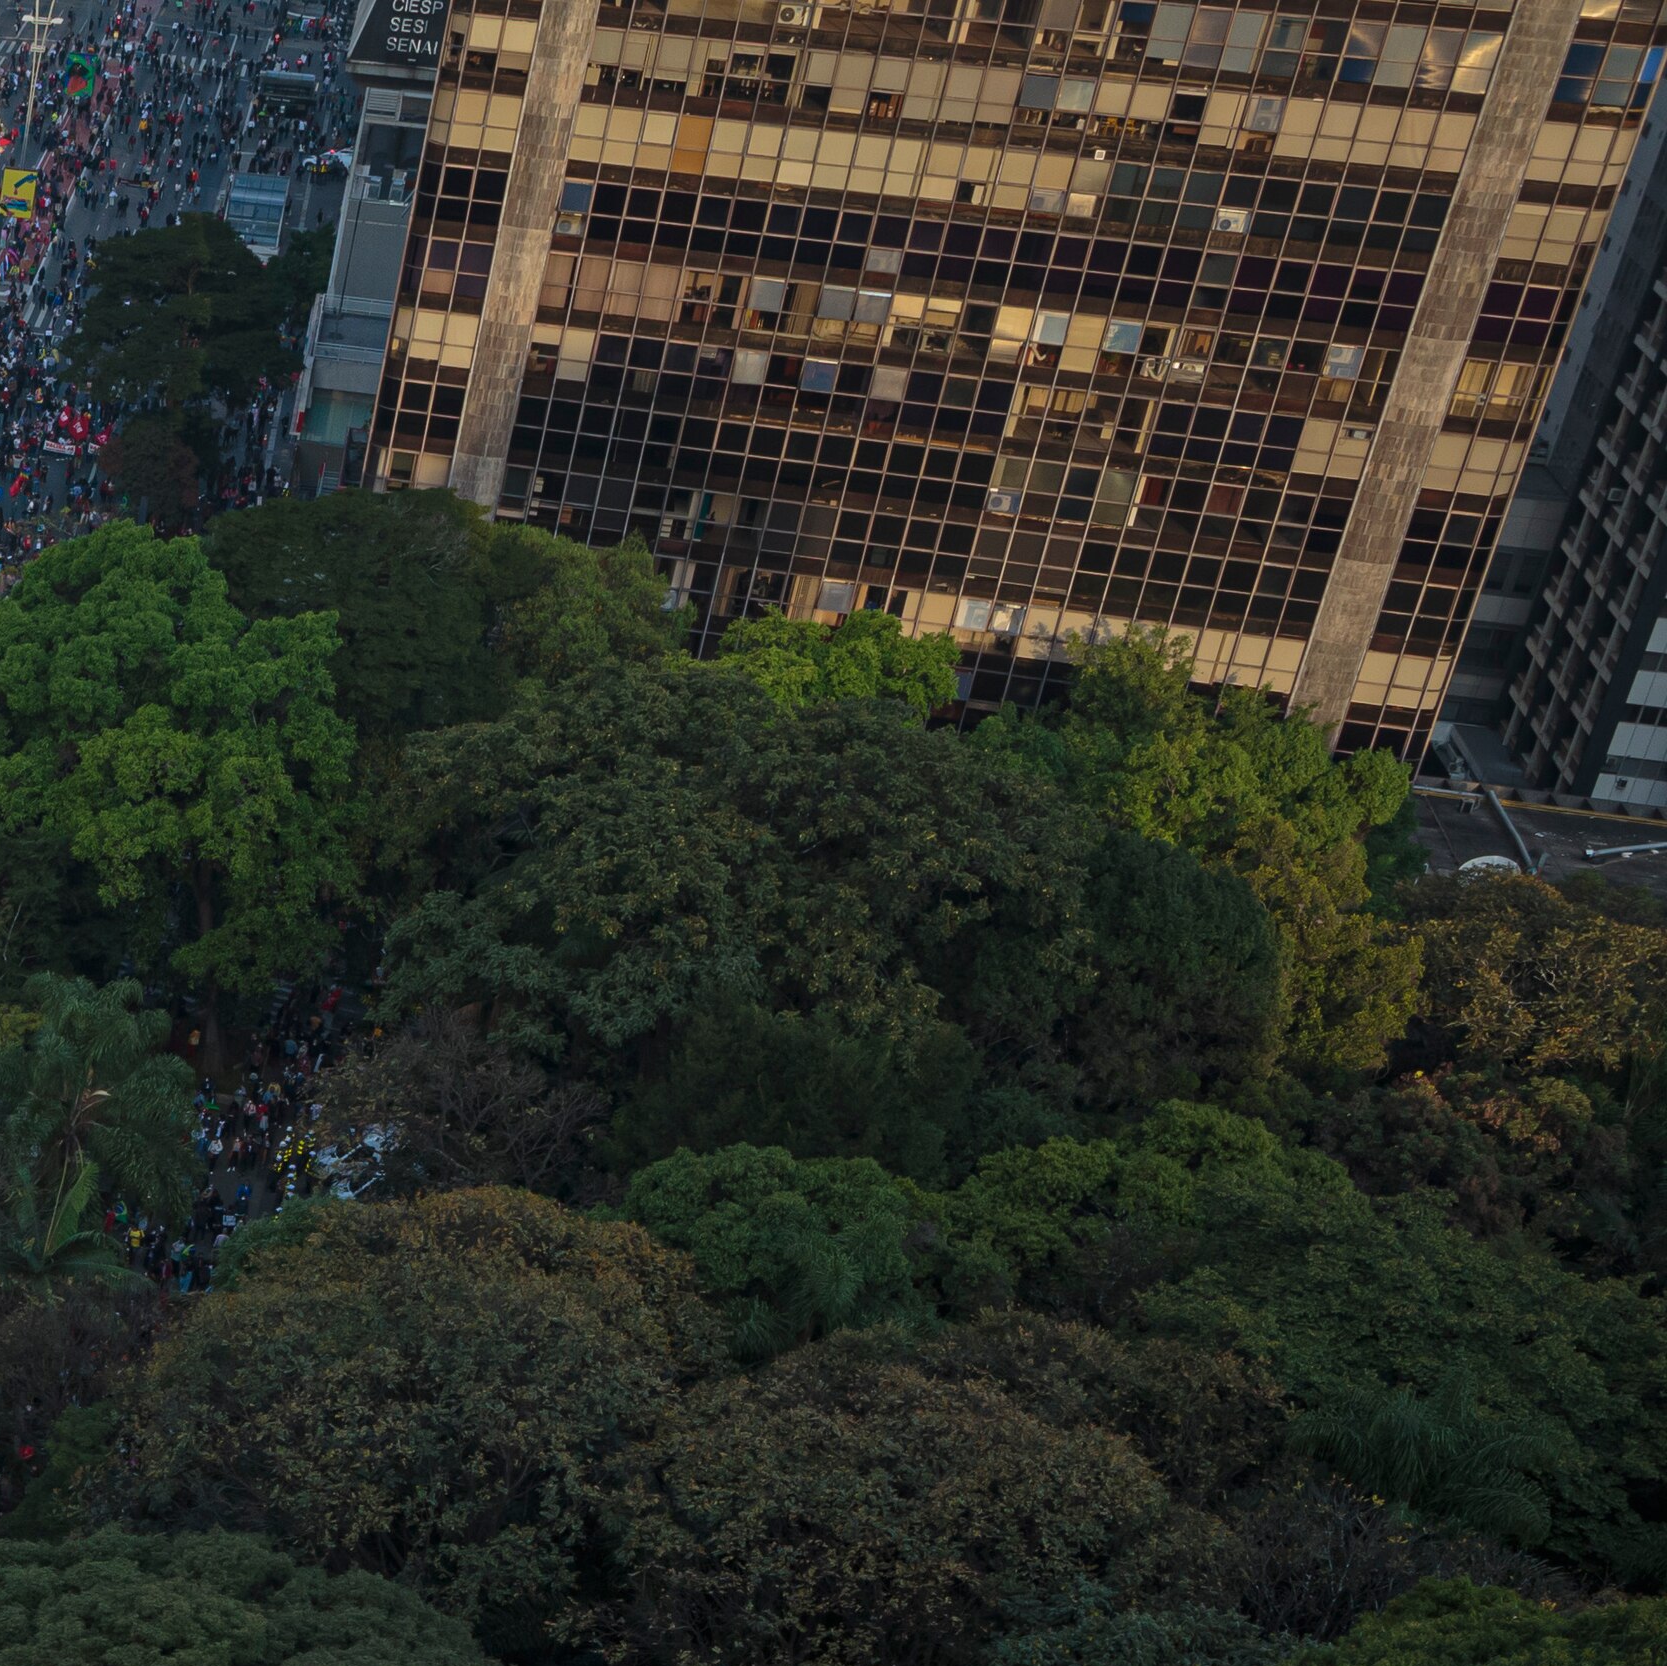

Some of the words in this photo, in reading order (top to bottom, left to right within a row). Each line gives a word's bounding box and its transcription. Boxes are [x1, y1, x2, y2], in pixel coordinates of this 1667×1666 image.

[392, 0, 444, 14] CIESP
[389, 17, 428, 34] SESI
[386, 36, 438, 55] SENAI
